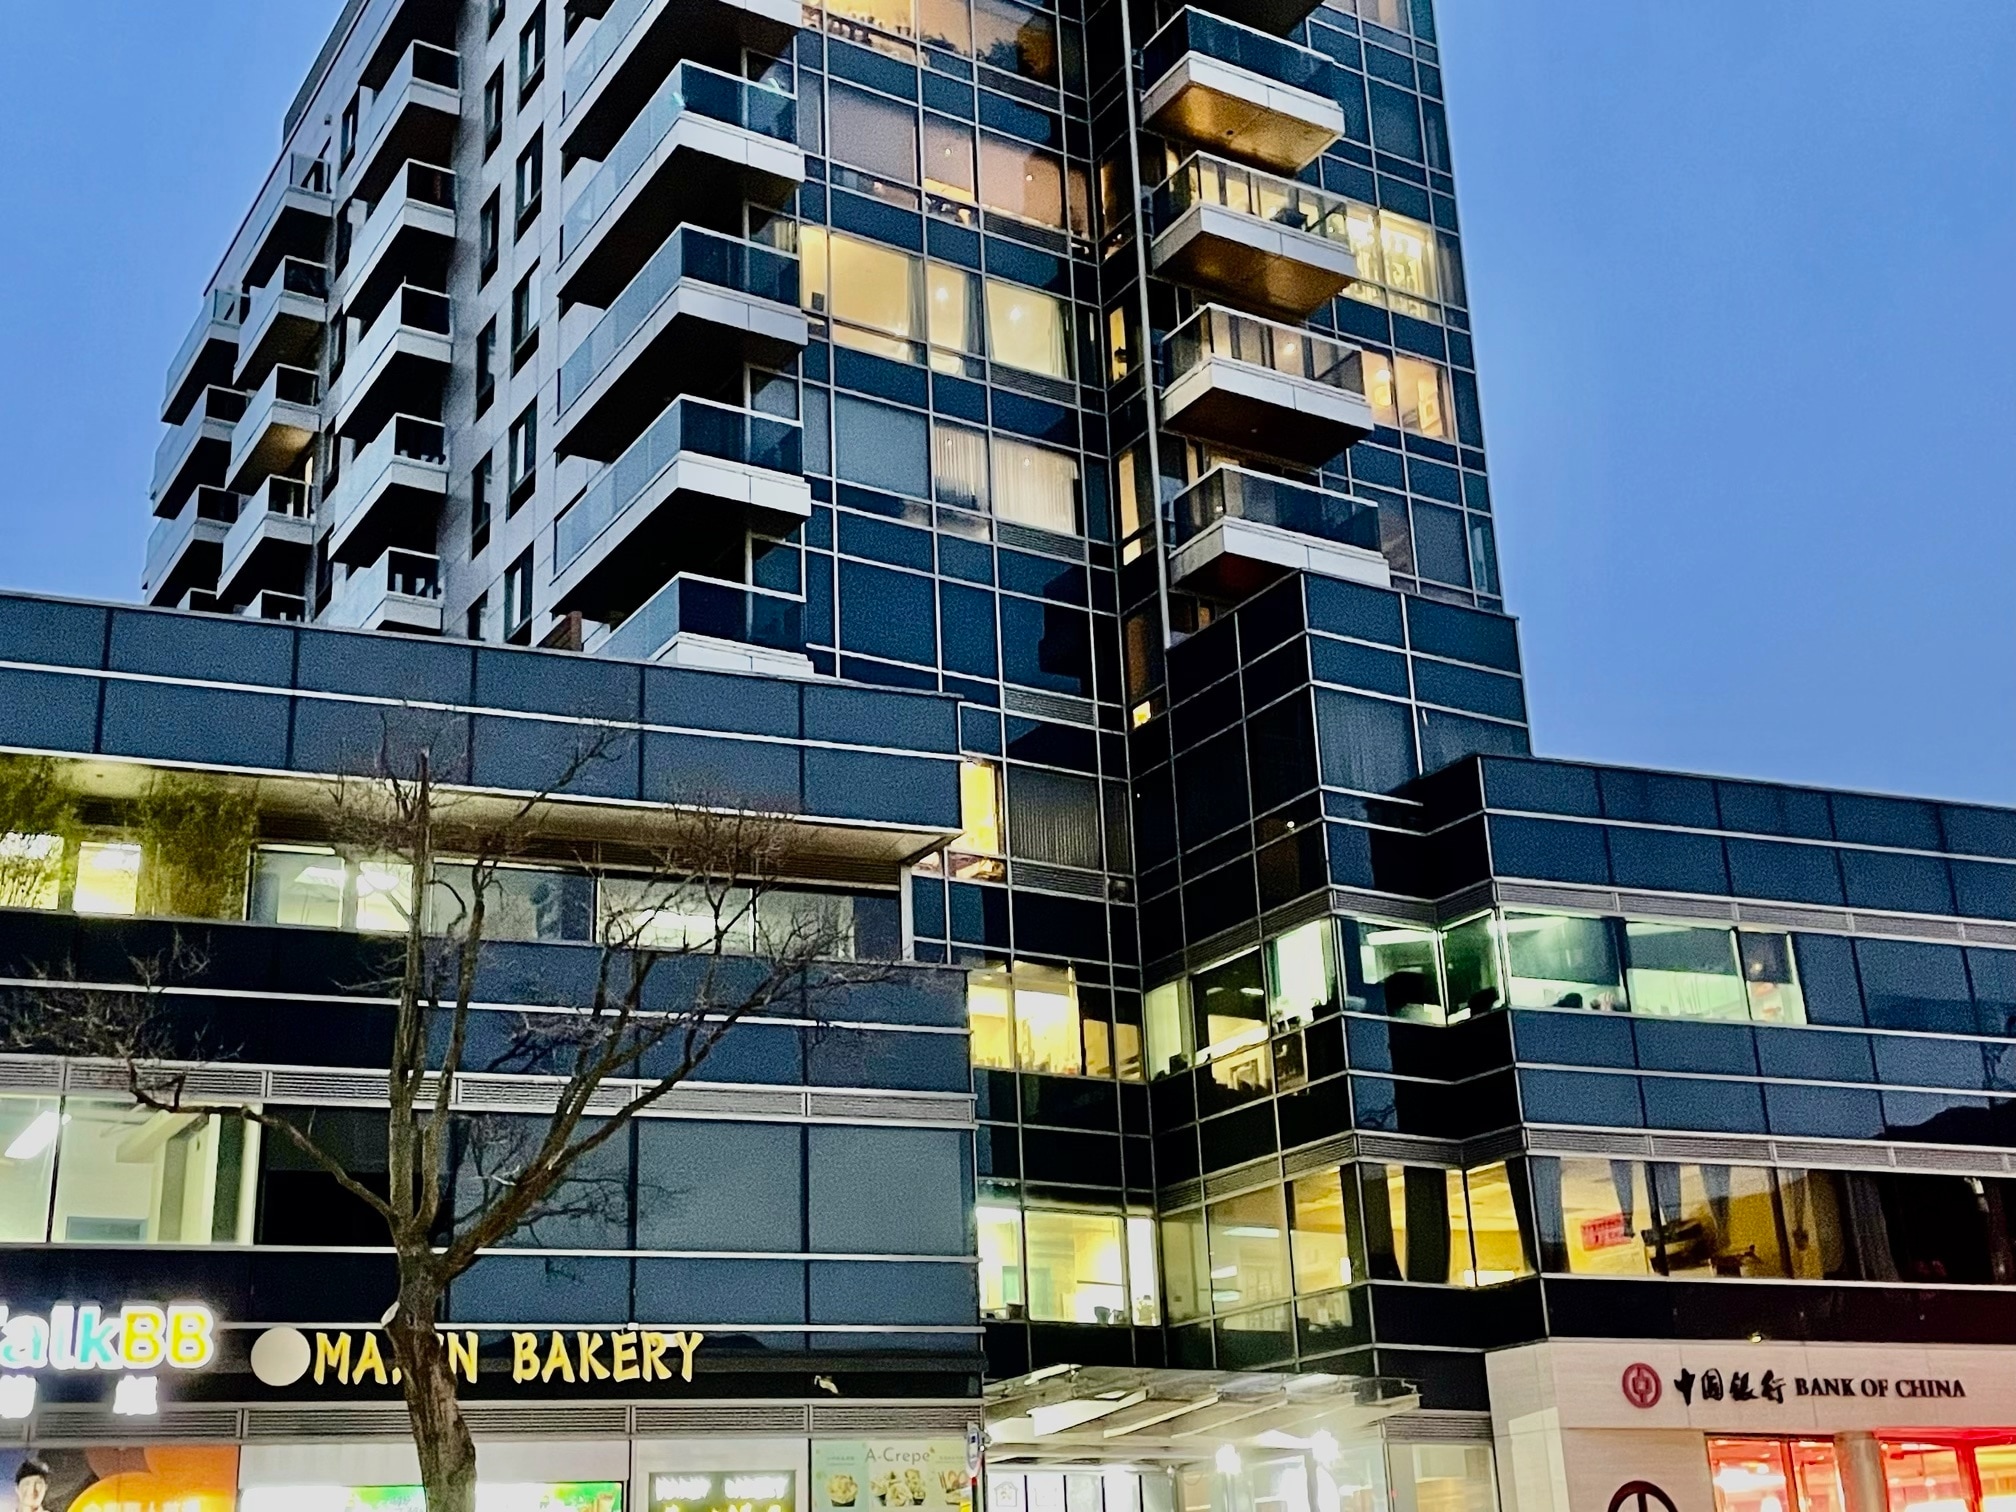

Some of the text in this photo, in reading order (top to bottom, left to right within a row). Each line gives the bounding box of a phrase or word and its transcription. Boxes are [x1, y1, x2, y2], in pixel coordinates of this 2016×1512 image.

[0, 1305, 214, 1370] alkBB
[314, 1331, 704, 1385] MAN BAKERY
[1795, 1377, 1966, 1398] BANK OF CHINA
[865, 1446, 931, 1465] A-Crepe
